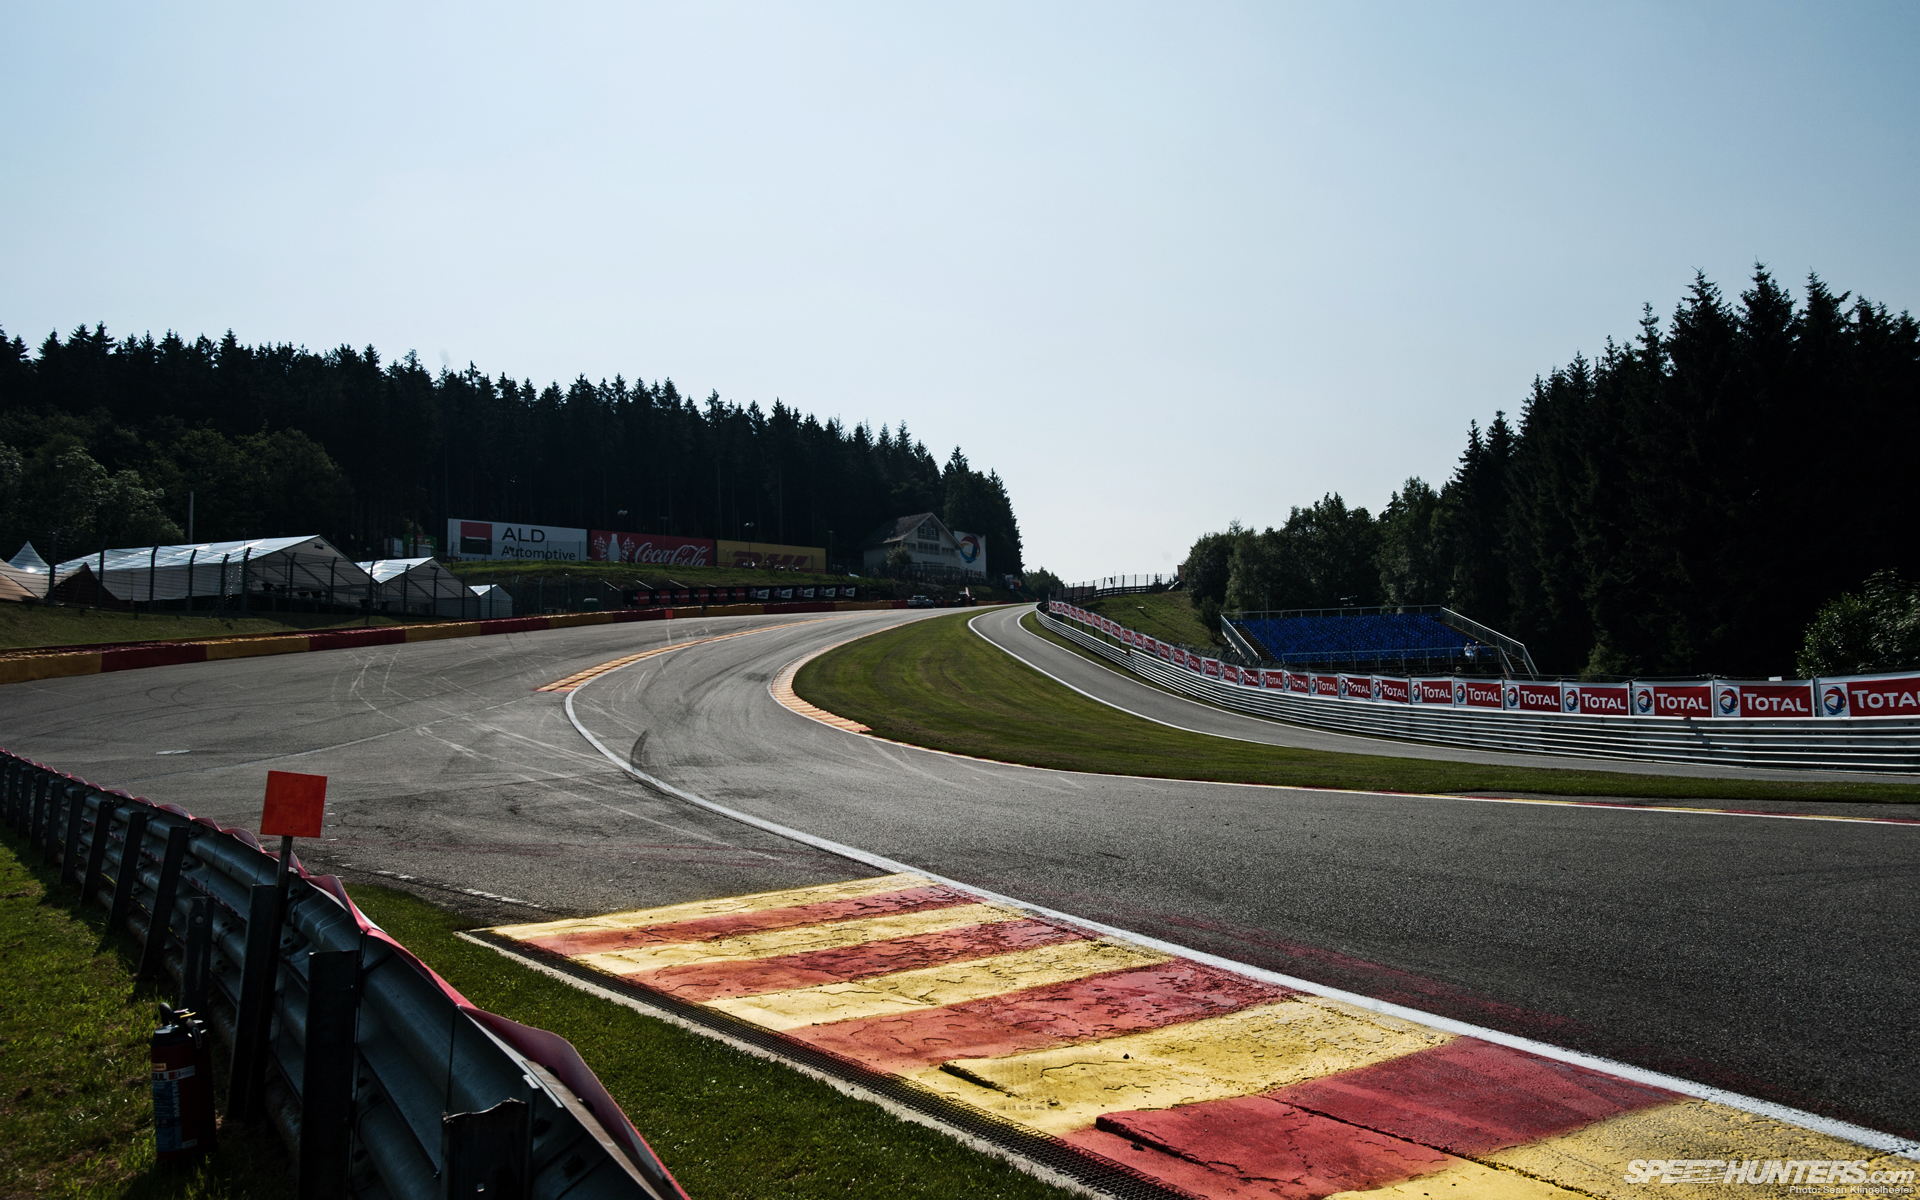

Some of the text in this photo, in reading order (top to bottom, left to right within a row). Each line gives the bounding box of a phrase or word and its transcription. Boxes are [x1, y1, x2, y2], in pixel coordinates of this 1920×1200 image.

[501, 527, 545, 543] ALD
[501, 545, 576, 561] Automotive
[634, 542, 711, 567] Coca-Cola
[1174, 651, 1185, 662] TOTAL
[1189, 657, 1200, 669] TOTAL
[1206, 663, 1218, 673] TOTAL
[1224, 669, 1237, 680] TOTAL
[1266, 675, 1282, 685] TOTAL
[1318, 681, 1338, 692] TOTAL
[1348, 682, 1371, 694] TOTAL
[1383, 684, 1408, 698] TOTAL
[1423, 685, 1451, 699] TOTAL
[1468, 688, 1500, 702] TOTAL
[1521, 690, 1559, 706] TOTAL
[1582, 693, 1626, 710] TOTAL
[1656, 693, 1709, 710] TOTAL
[1743, 693, 1809, 713] TOTAL
[1851, 689, 1920, 709] TOTA
[172, 1080, 180, 1117] MASTER
